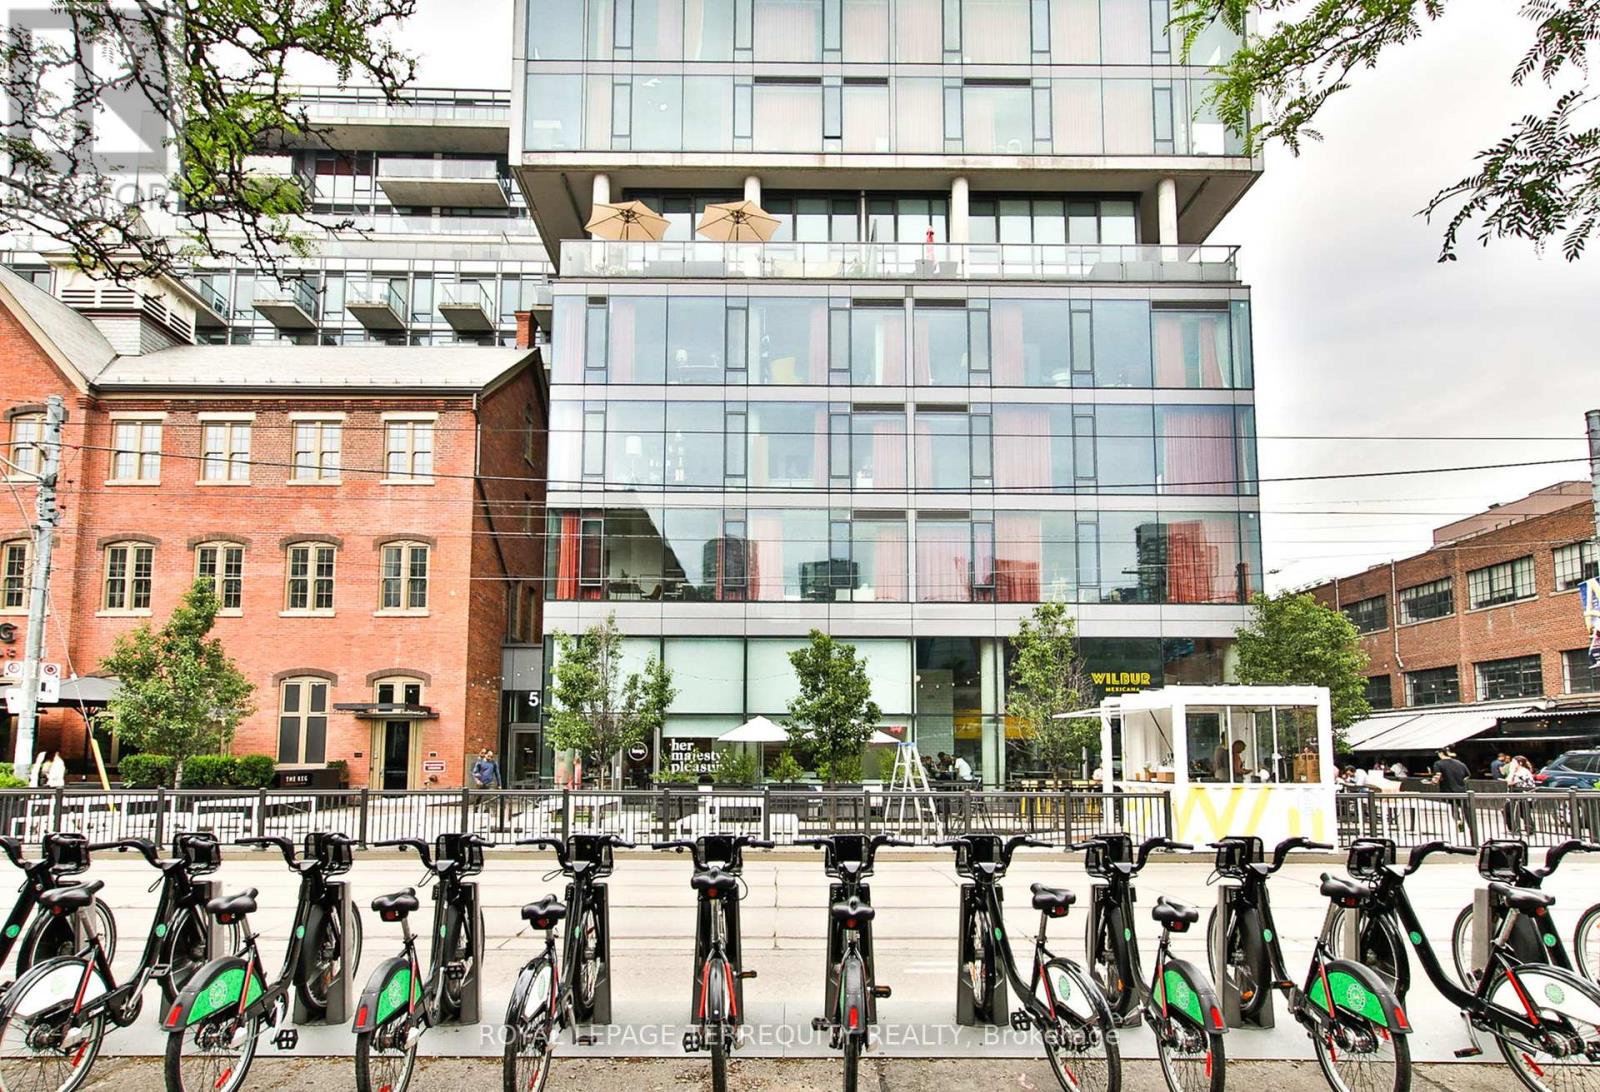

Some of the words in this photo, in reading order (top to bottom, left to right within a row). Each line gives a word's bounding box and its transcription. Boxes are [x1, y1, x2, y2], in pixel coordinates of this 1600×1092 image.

[1091, 672, 1151, 685] WILBUR
[528, 691, 541, 707] 5
[671, 738, 695, 751] her
